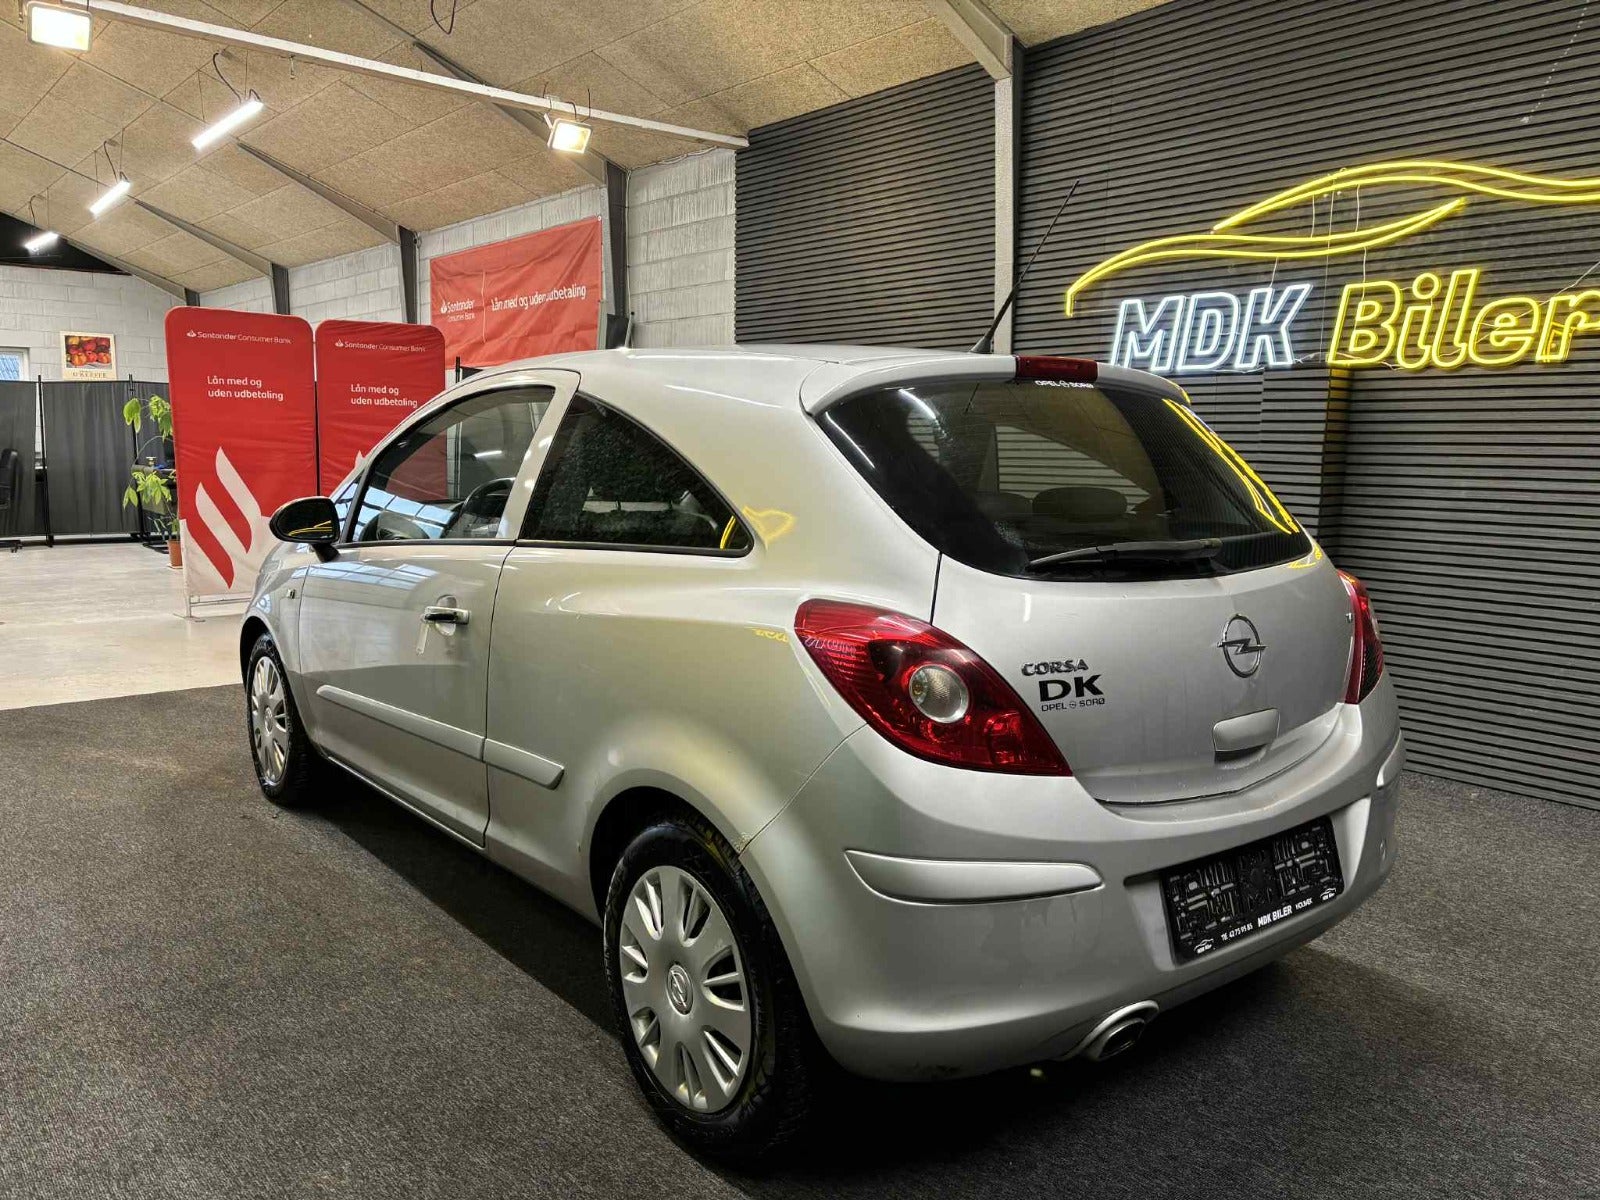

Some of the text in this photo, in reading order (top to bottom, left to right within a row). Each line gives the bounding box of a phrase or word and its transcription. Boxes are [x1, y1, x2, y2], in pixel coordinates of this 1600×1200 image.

[519, 295, 529, 310] og
[1110, 268, 1600, 371] MDK Biler
[197, 331, 292, 344] Santander Consumer Bank
[344, 341, 378, 350] Santander
[207, 375, 225, 385] Lån
[226, 377, 248, 386] med
[208, 389, 284, 401] uden udbetaling
[350, 384, 399, 396] Lån med og
[350, 397, 418, 408] uden udbetaling
[1021, 658, 1089, 676] CORSA
[1038, 674, 1104, 702] DK
[1041, 702, 1067, 712] OPEL
[1272, 905, 1292, 920] BILER
